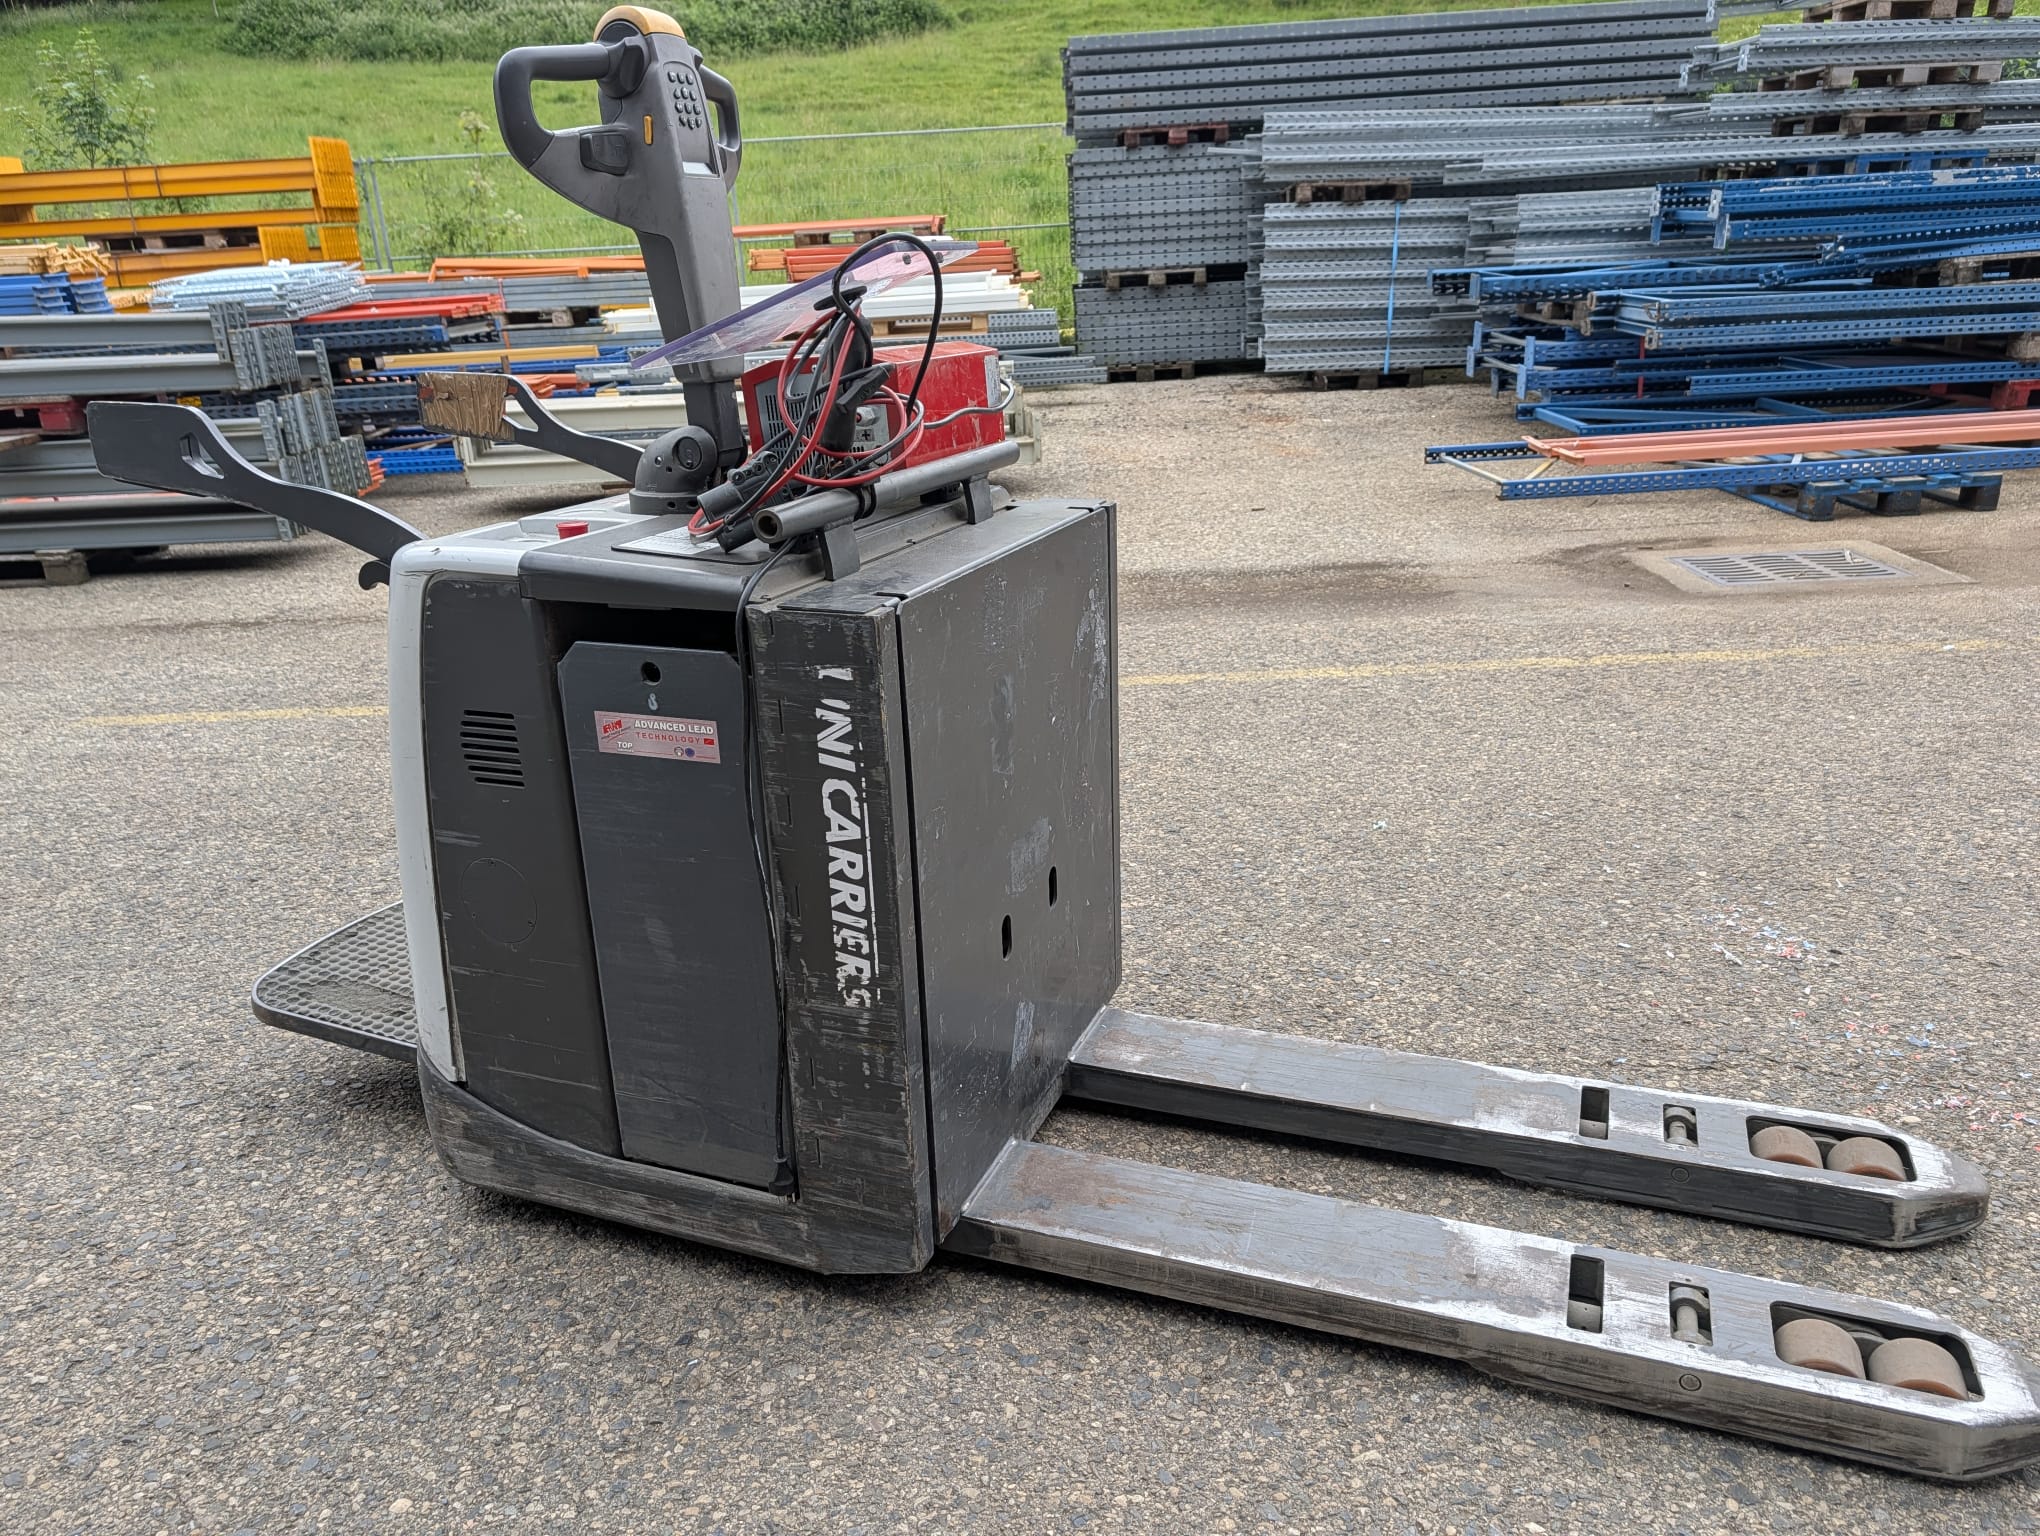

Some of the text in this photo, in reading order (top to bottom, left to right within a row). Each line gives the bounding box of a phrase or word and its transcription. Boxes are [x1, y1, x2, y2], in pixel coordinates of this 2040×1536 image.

[634, 720, 686, 732] ADVANCED
[688, 724, 714, 735] LEAD
[635, 732, 700, 744] TECHNOLOGY
[617, 741, 633, 749] TOP
